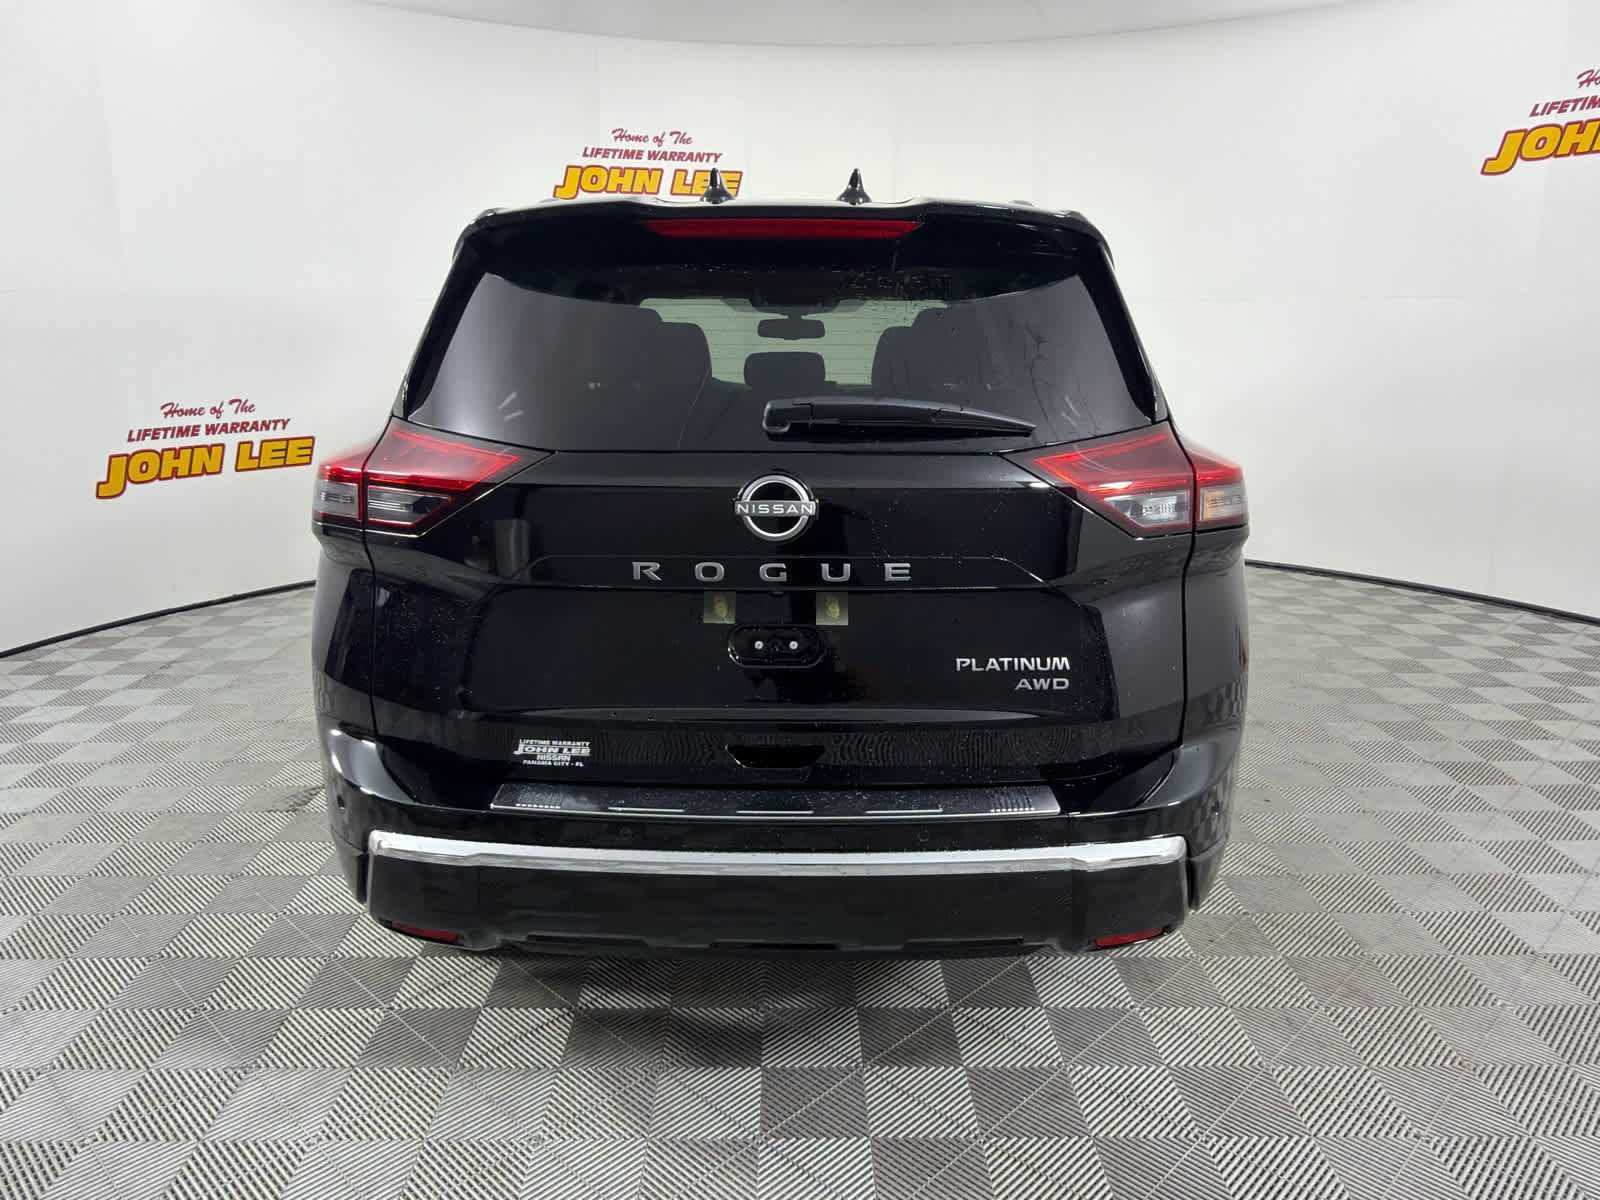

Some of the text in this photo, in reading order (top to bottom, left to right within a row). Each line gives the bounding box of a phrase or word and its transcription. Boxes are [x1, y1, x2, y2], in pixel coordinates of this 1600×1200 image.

[612, 128, 693, 147] Home of The
[582, 147, 722, 163] LIFETIME WARRANTY
[553, 165, 664, 199] JOHN
[160, 399, 256, 419] Home of The
[127, 418, 291, 442] LIFETIME WARRANTY
[96, 436, 315, 499] JOHN LEE
[737, 503, 815, 515] NISSAN
[632, 561, 911, 582] ROGUE
[955, 657, 1071, 671] PLATINUM
[1015, 678, 1070, 690] AWD
[513, 744, 591, 755] JOHN LEE
